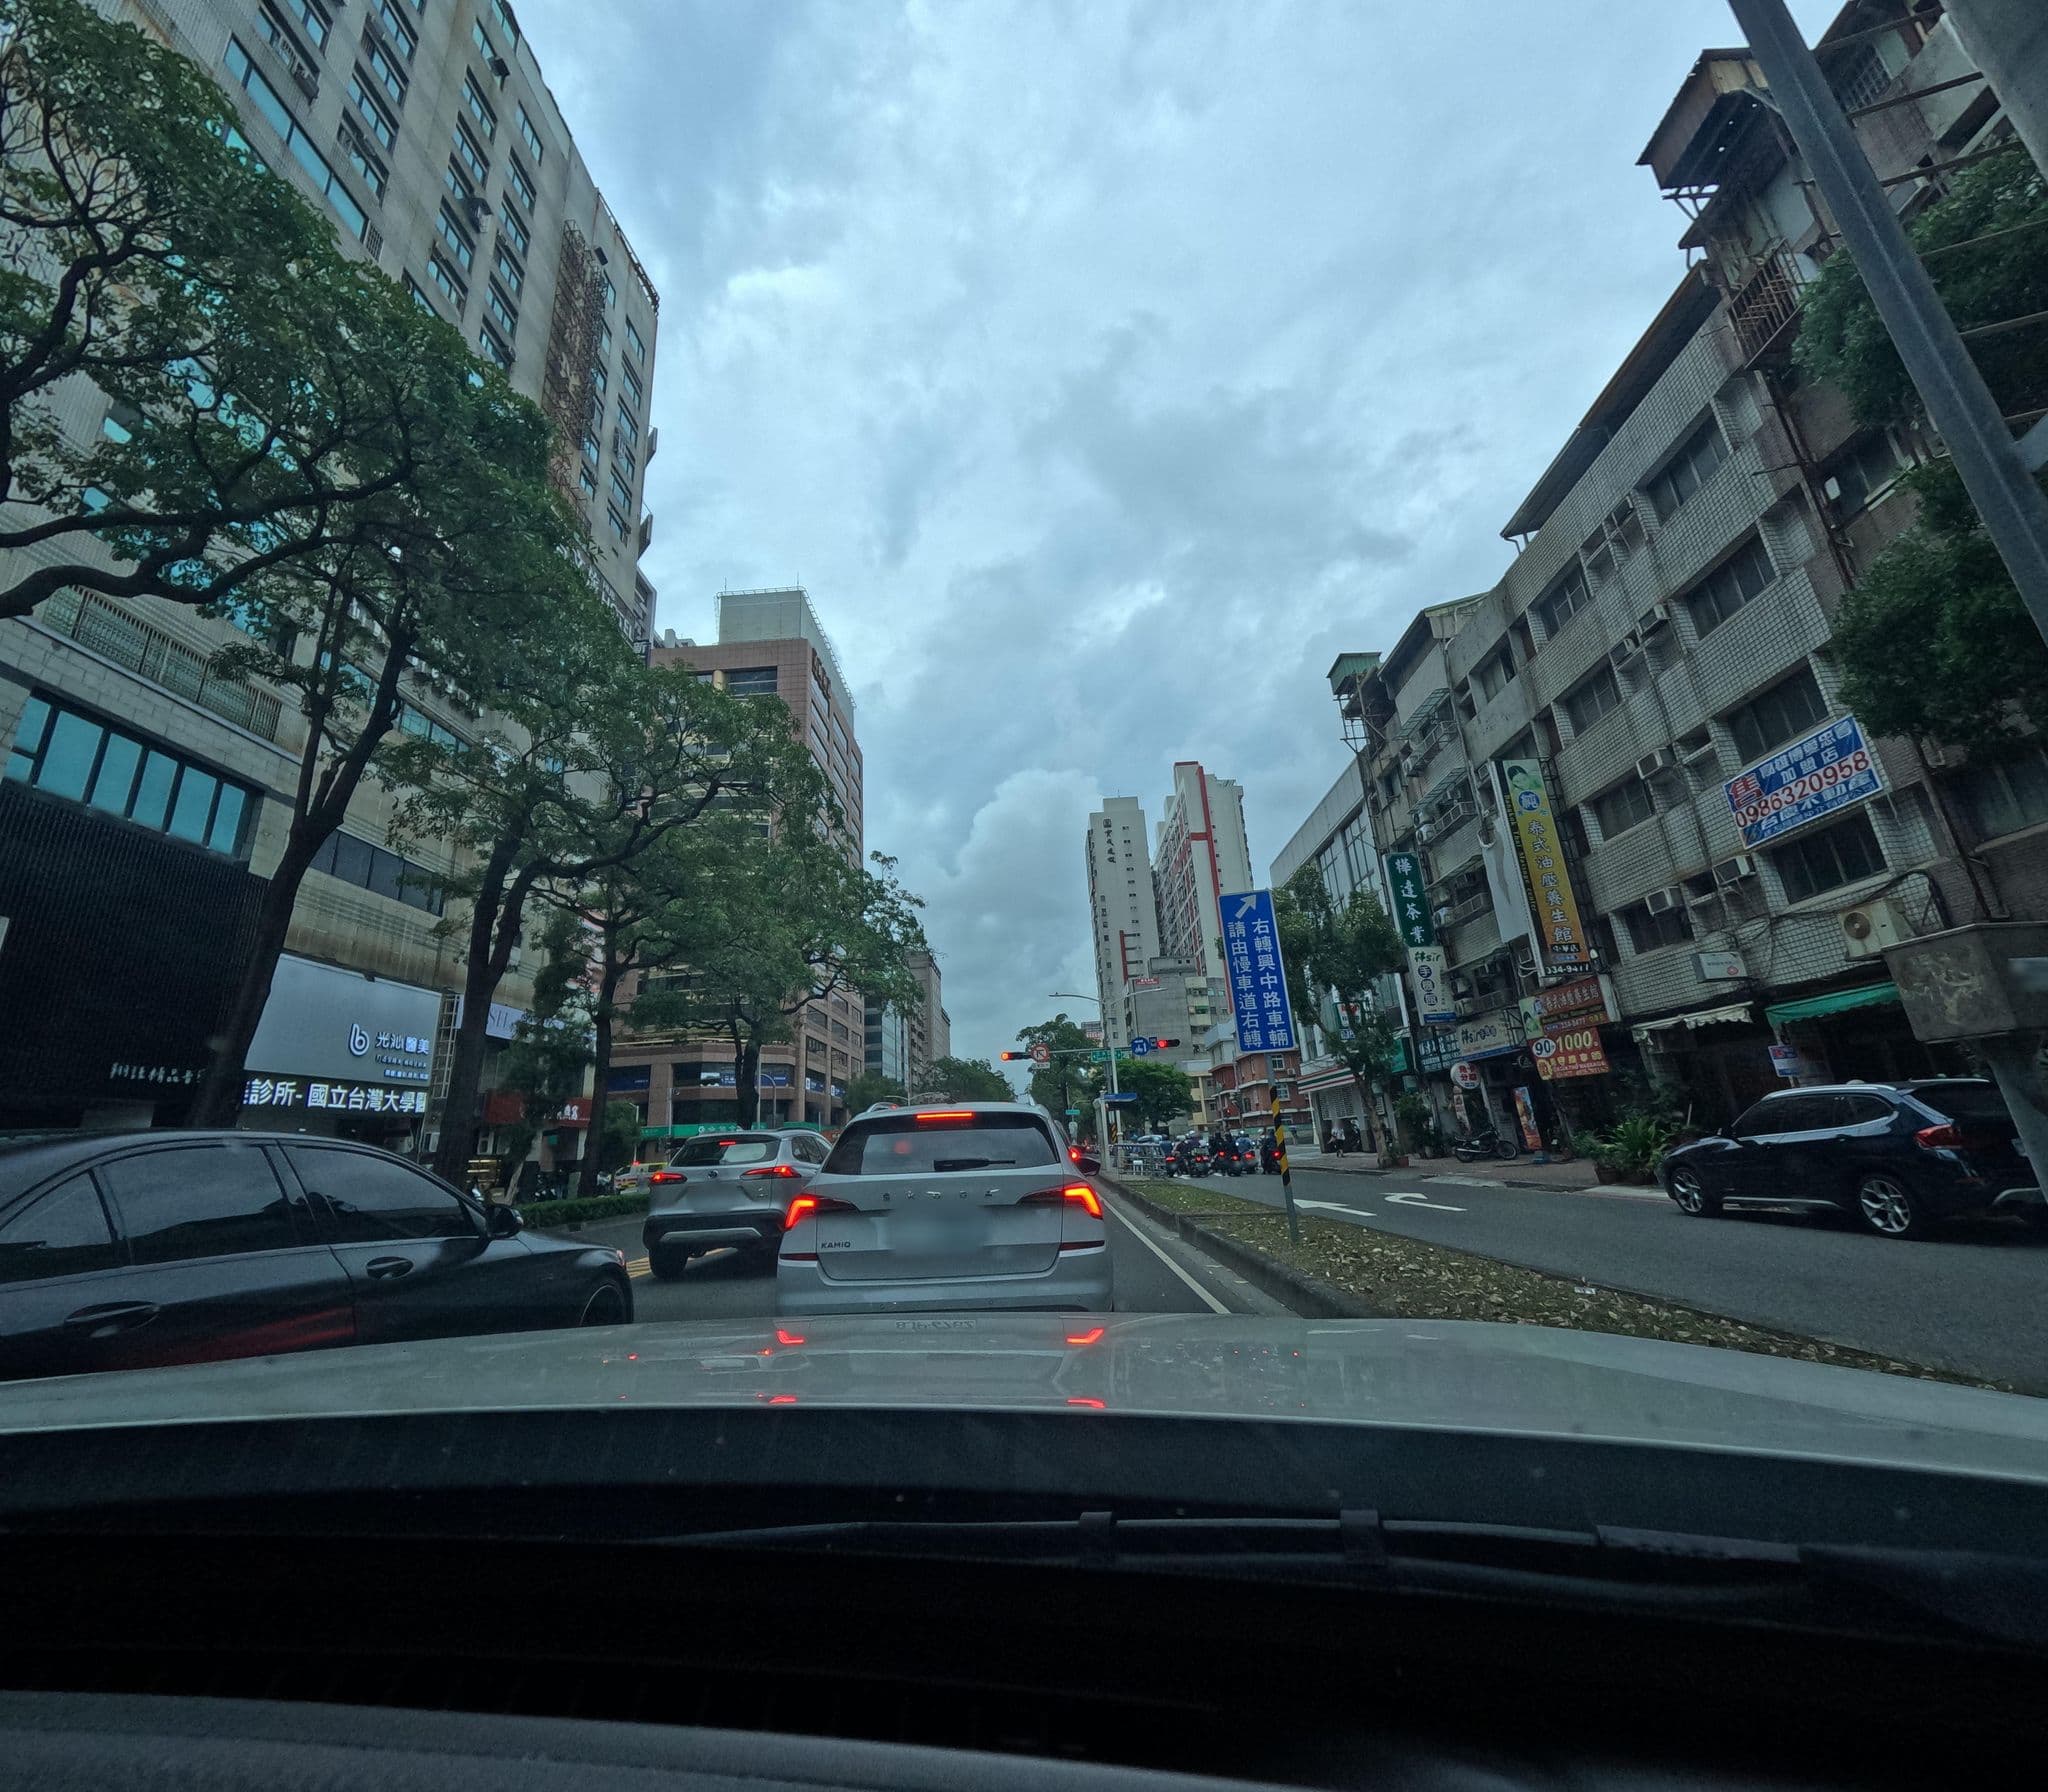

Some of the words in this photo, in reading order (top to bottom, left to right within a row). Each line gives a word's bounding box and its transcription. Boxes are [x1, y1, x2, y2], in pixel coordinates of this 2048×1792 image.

[1729, 773, 1765, 809] 售
[1736, 751, 1869, 828] 0986320958
[1781, 746, 1839, 784] 加盟店
[1761, 771, 1873, 831] 台慶不動產
[1394, 857, 1424, 943] 樺達茶業
[1528, 820, 1573, 942] 泰式油壓養生館
[1228, 921, 1262, 1048] 請由慢車道右轉
[1252, 918, 1289, 1046] 右轉興中路車輛
[1535, 1039, 1551, 1056] 90
[1556, 1030, 1592, 1053] 1000
[821, 1241, 851, 1249] KAMIQ
